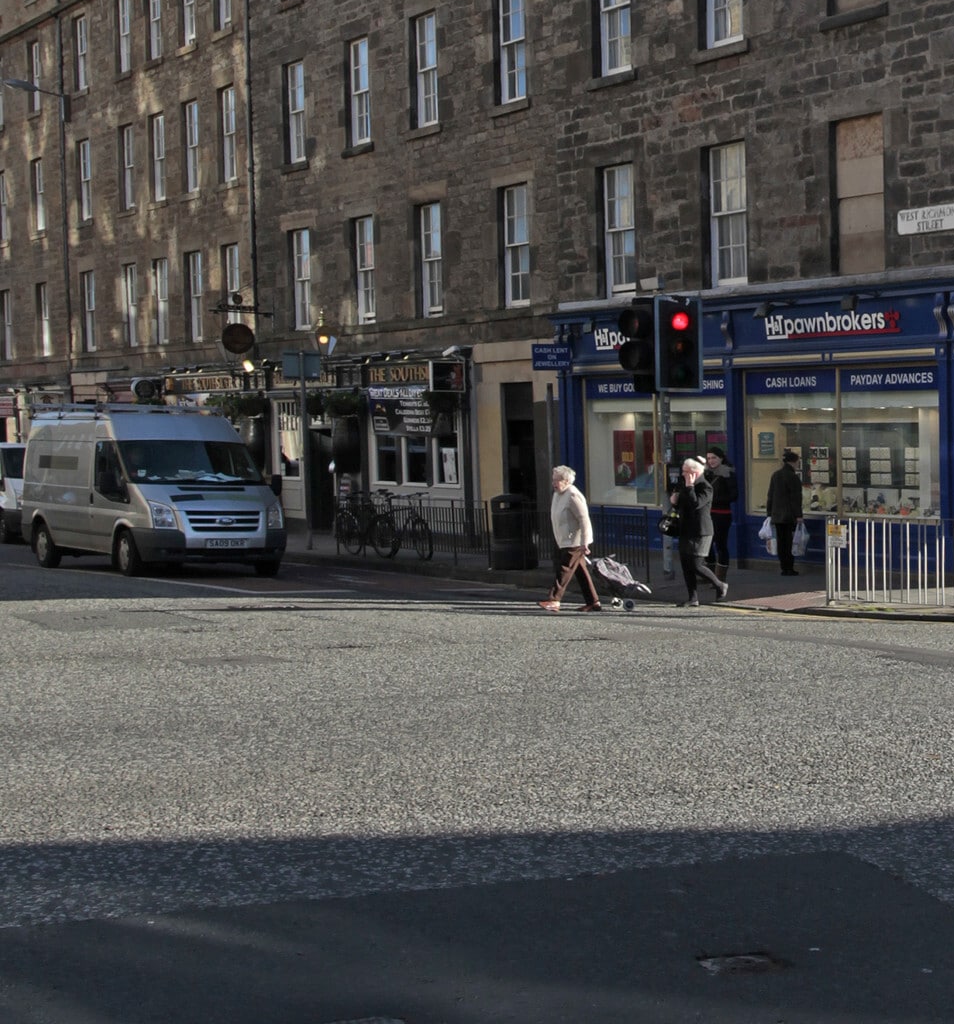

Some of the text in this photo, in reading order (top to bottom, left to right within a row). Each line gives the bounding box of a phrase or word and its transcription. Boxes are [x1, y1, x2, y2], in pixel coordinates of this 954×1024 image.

[900, 211, 919, 221] WEST
[917, 219, 944, 231] STREET
[369, 366, 426, 382] THE SOUTHS
[850, 372, 934, 385] PAYDAY ADVANCES
[598, 383, 635, 393] WE BUY GO
[702, 379, 724, 389] SHING
[765, 376, 817, 388] CASH LOANS
